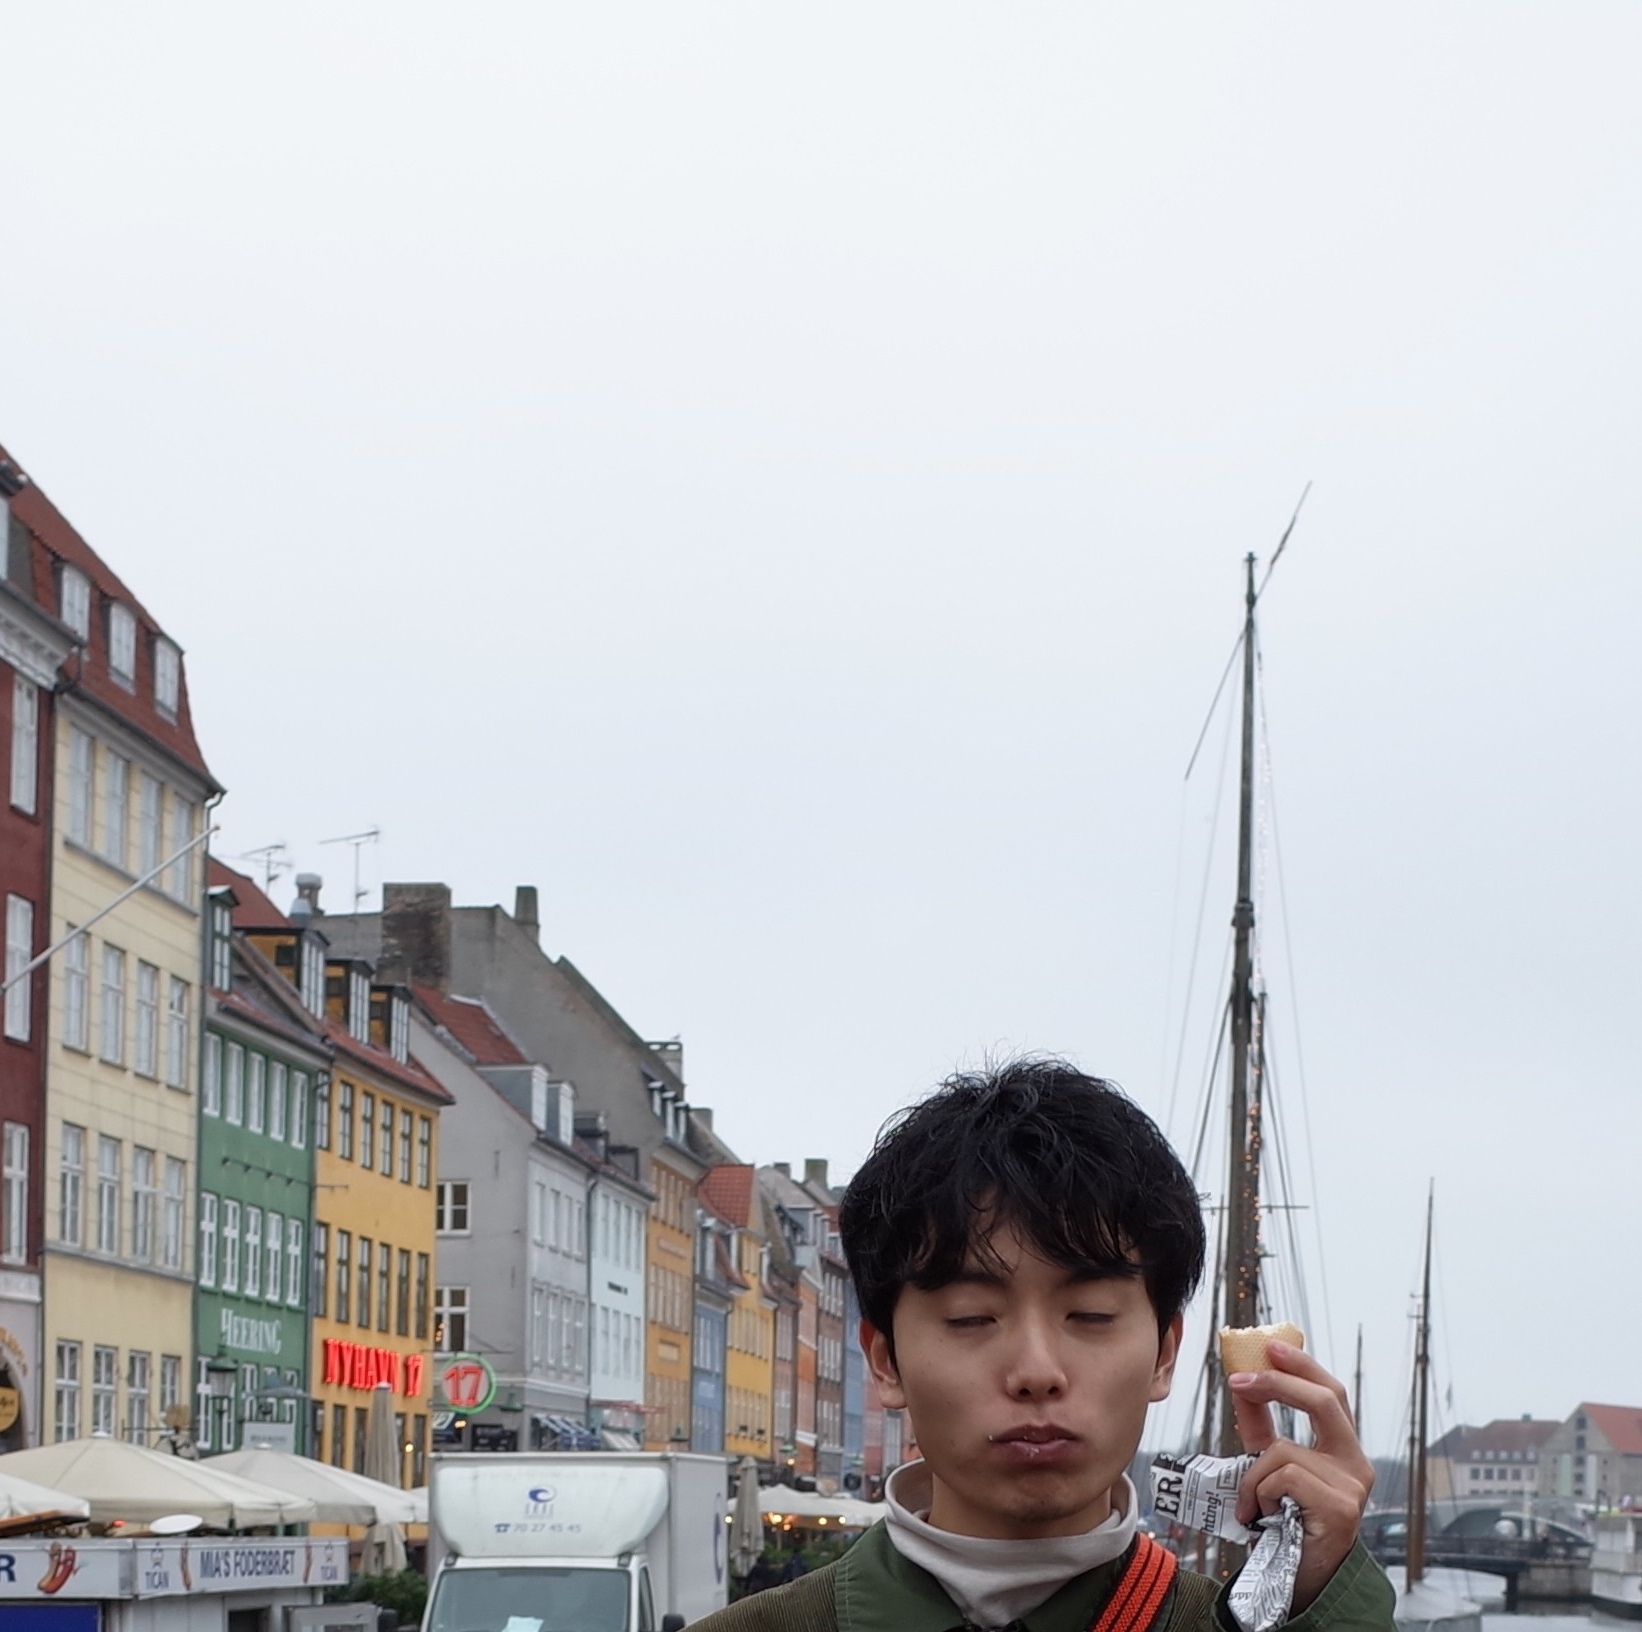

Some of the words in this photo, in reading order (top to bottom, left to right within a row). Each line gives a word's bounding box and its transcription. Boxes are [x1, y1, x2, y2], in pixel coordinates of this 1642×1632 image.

[221, 1308, 282, 1354] HEERING
[324, 1338, 401, 1392] NYHAVN
[406, 1354, 424, 1397] 17
[445, 1365, 485, 1406] 17
[145, 1571, 170, 1589] TICAN
[200, 1550, 231, 1578] MIA'S
[320, 1565, 338, 1581] TICAN
